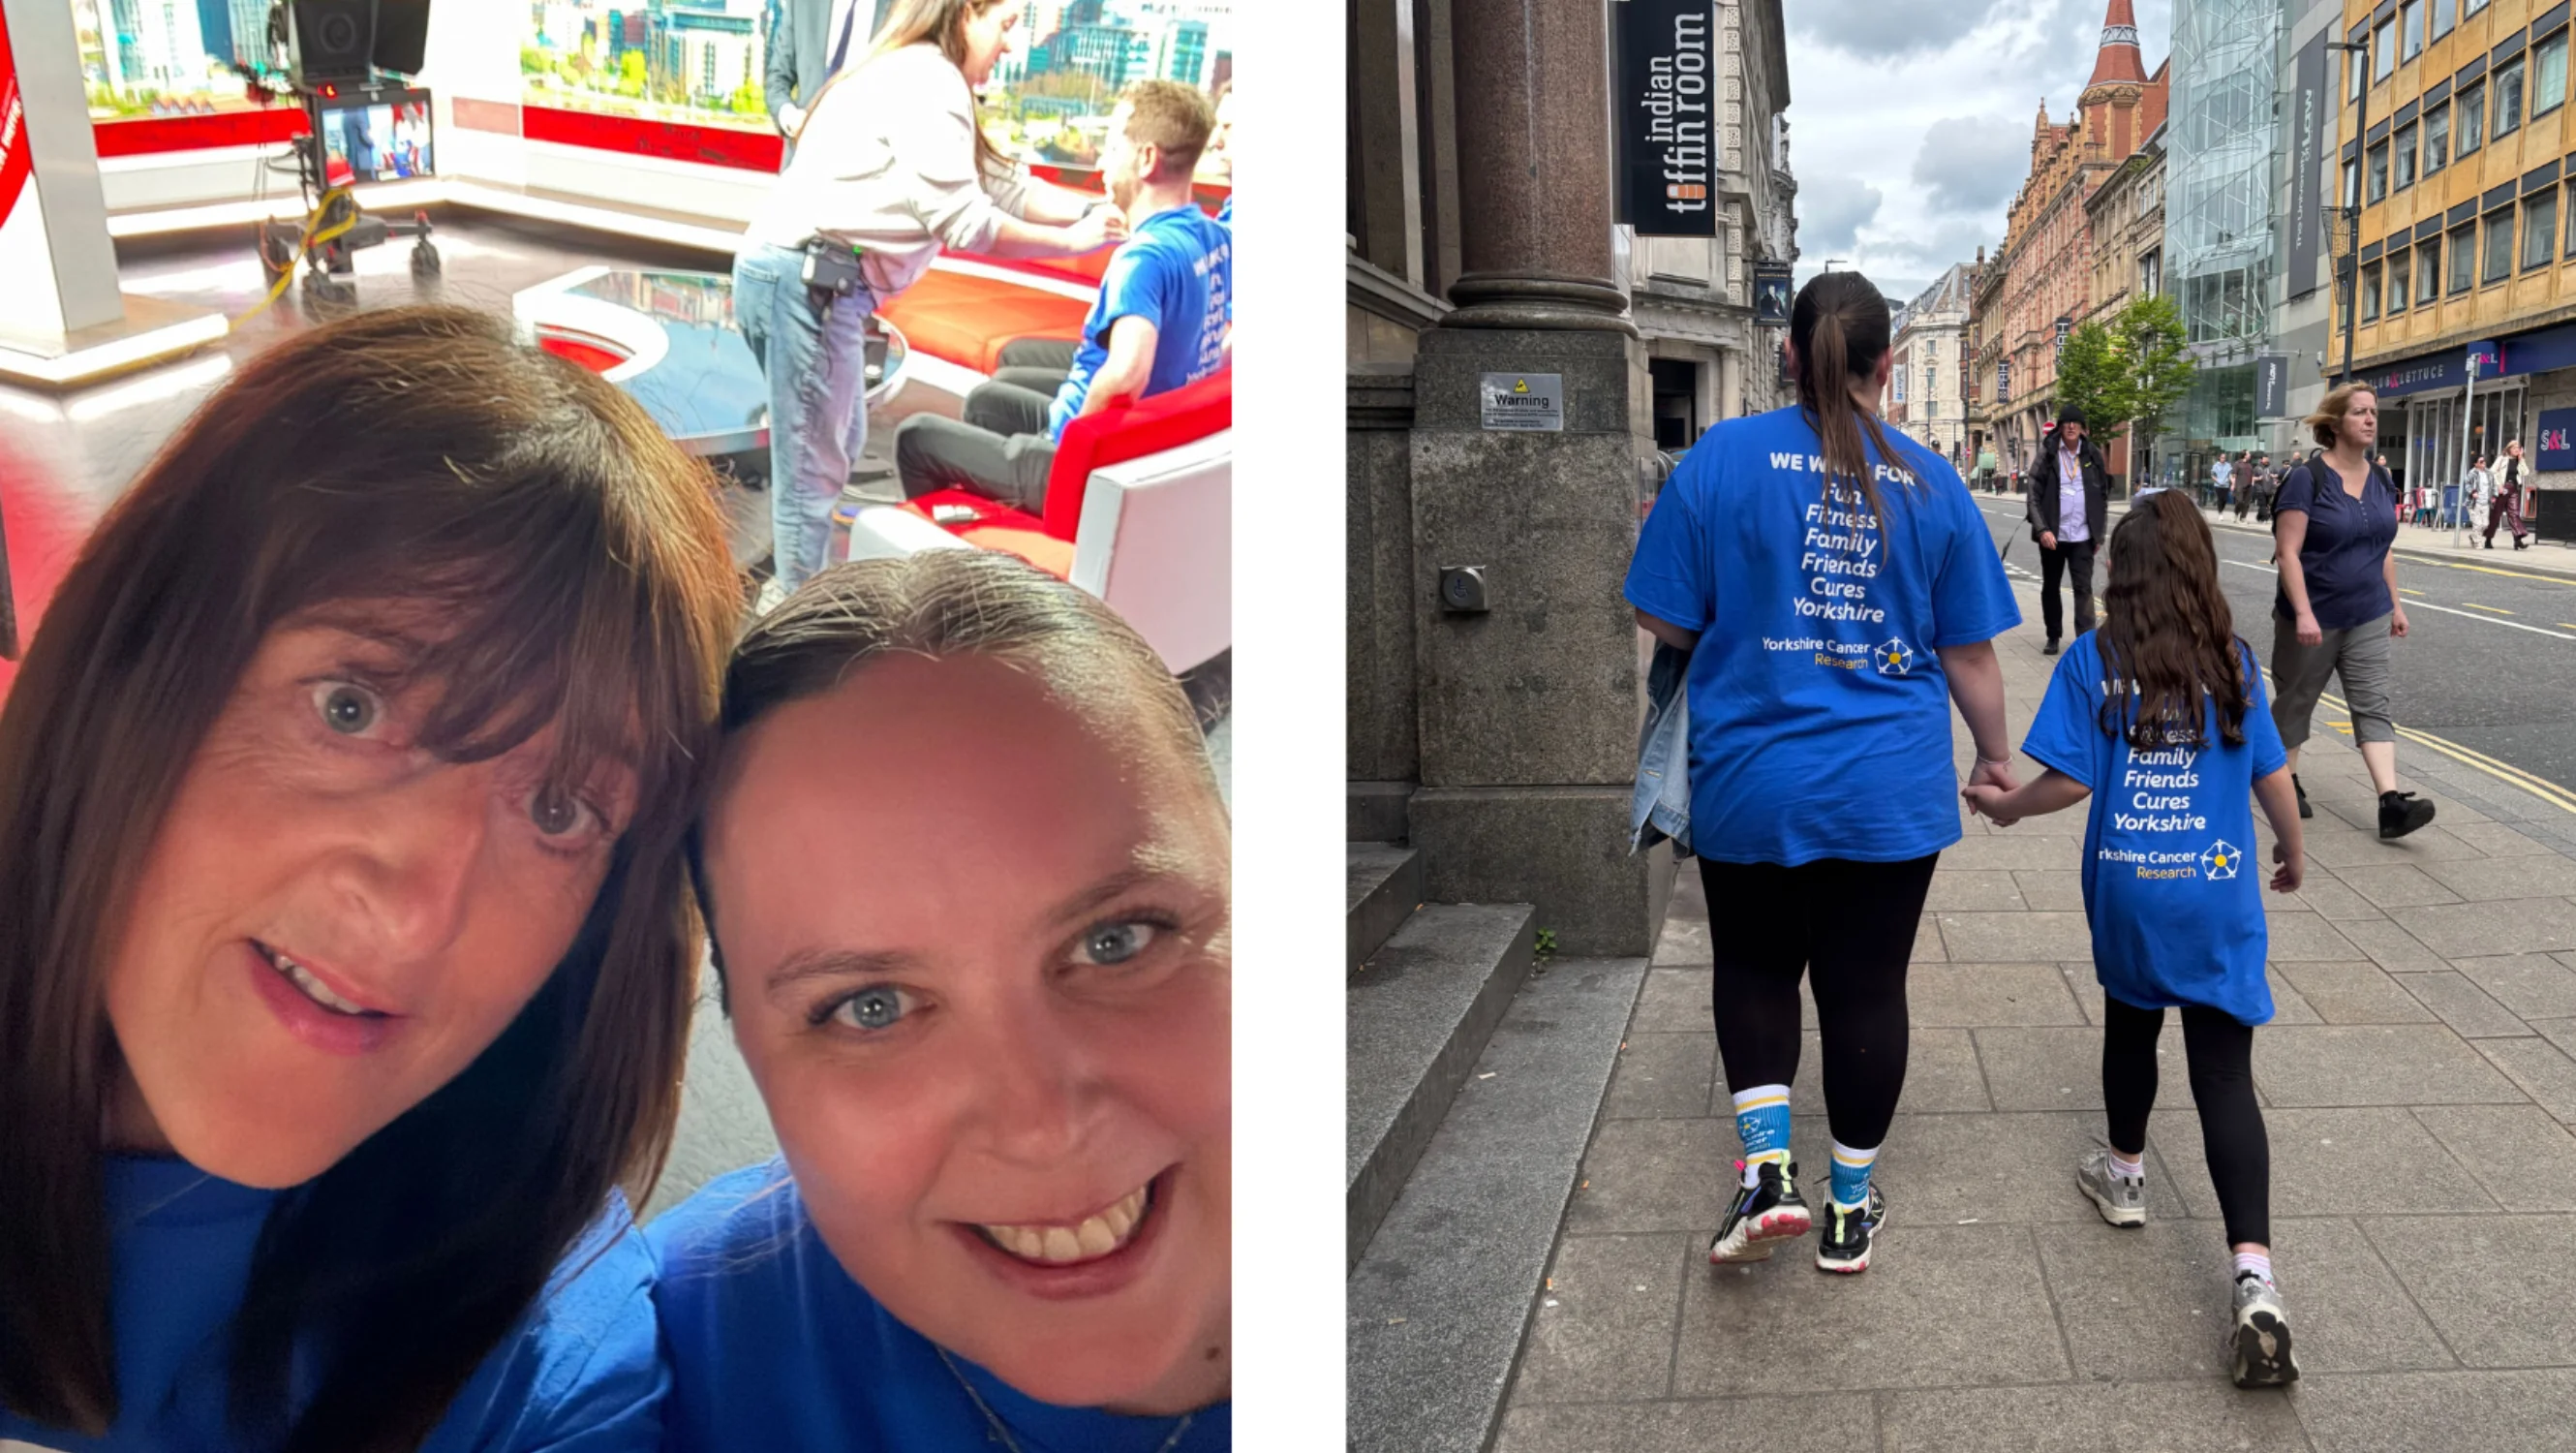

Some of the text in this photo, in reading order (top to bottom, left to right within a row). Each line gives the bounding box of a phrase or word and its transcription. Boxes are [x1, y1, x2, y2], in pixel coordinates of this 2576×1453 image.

[1674, 13, 1706, 113] room
[1641, 55, 1672, 142] indian
[1494, 394, 1549, 409] Warning
[2540, 428, 2570, 451] S&L
[1769, 451, 1803, 472] WE
[1875, 464, 1916, 487] FOR
[1822, 482, 1862, 505] Fun
[1805, 504, 1878, 529] Fitness
[1804, 527, 1877, 558] Family
[1801, 552, 1877, 578] Friends
[1810, 577, 1865, 599] Cures
[1794, 597, 1885, 623] Yorkshire
[1763, 636, 1871, 655] Yorkshire Cancer
[1814, 653, 1868, 669] Research
[2127, 747, 2197, 770] Family
[2124, 770, 2199, 788] Friends
[2132, 792, 2191, 810] Cures
[2114, 813, 2206, 832] Yorkshire
[2098, 849, 2197, 864] rkshire Cancer
[2136, 865, 2196, 880] Research
